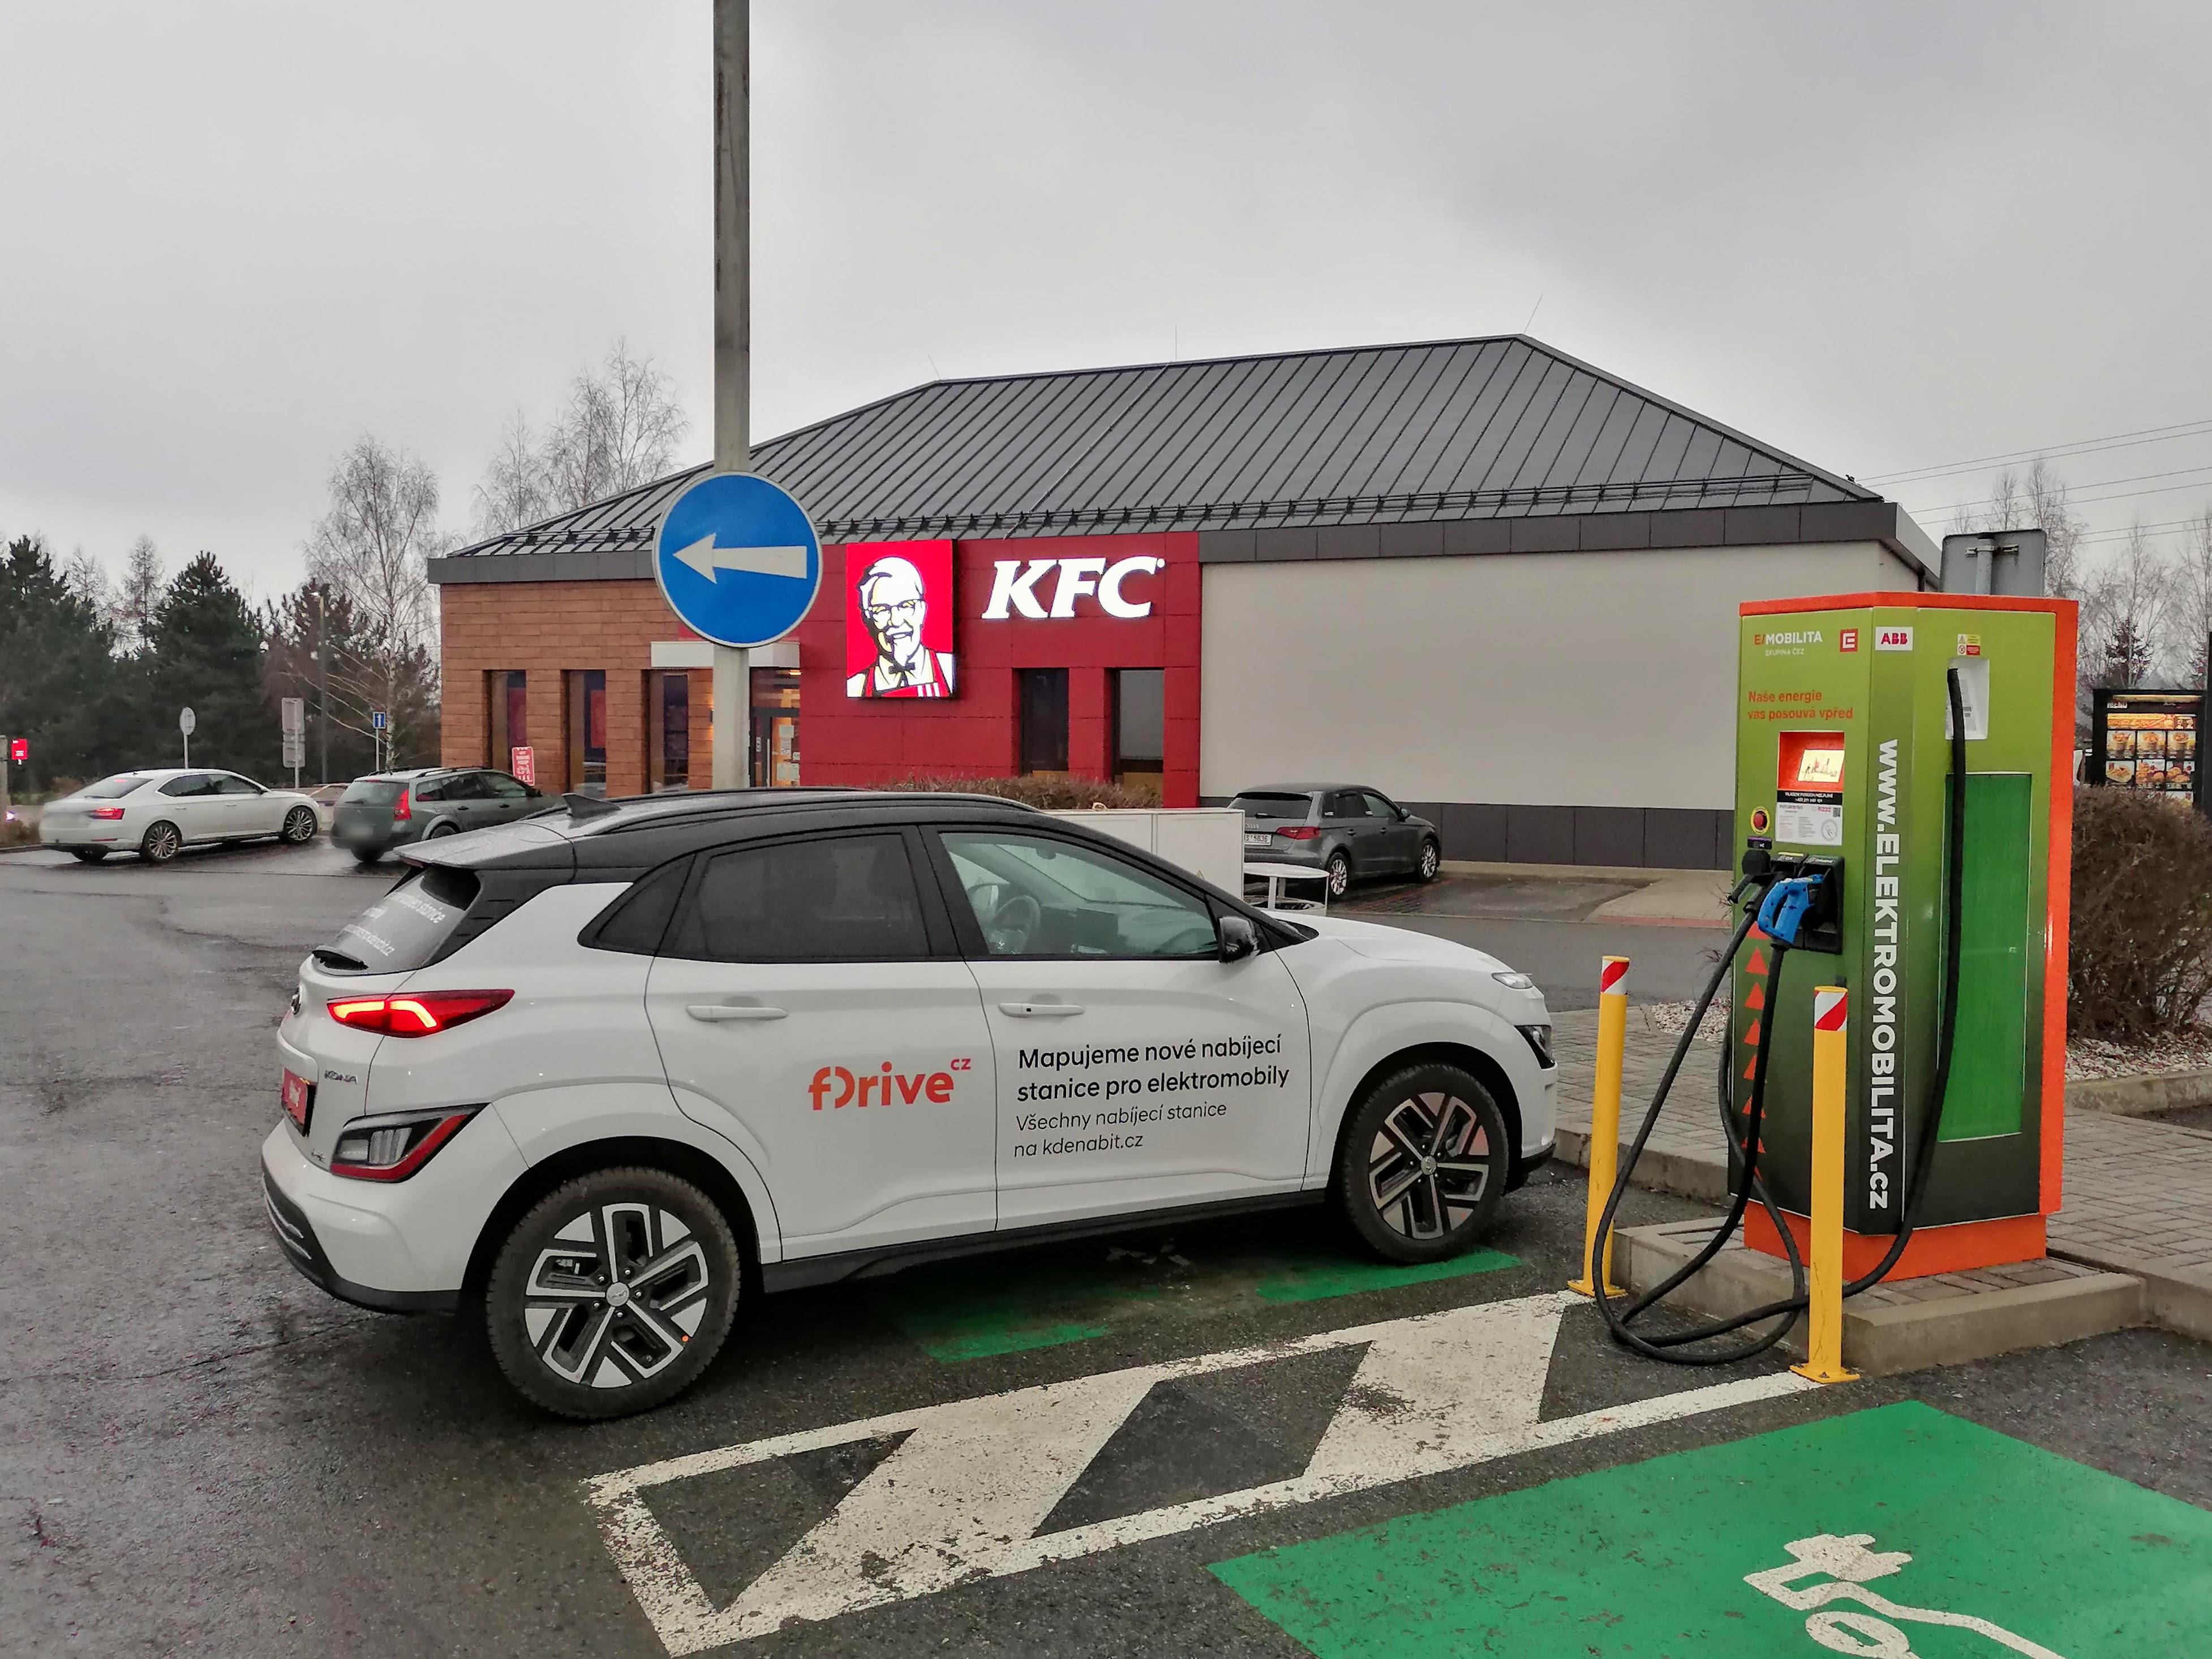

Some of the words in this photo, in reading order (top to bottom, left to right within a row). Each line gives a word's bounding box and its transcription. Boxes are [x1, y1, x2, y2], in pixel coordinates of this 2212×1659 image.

[981, 555, 1165, 619] KFC
[1880, 633, 1908, 644] ABB
[1749, 691, 1775, 703] Naše
[1779, 690, 1822, 703] energie
[1747, 708, 1766, 720] vás
[1769, 707, 1815, 721] posouvá
[1819, 707, 1853, 721] vpřed
[1019, 1044, 1140, 1071] Mapujeme
[1145, 1038, 1196, 1061] nové
[1201, 1034, 1281, 1059] nabíjecí
[1017, 1077, 1100, 1102] stanice
[1106, 1079, 1142, 1100] pro
[1147, 1064, 1290, 1093] elektromobily
[1016, 1112, 1091, 1131] Všechny
[1096, 1104, 1163, 1126] nabíjecí
[1167, 1101, 1227, 1120] stanice
[1014, 1144, 1037, 1157] na
[1042, 1133, 1143, 1155] kdenabit.cz
